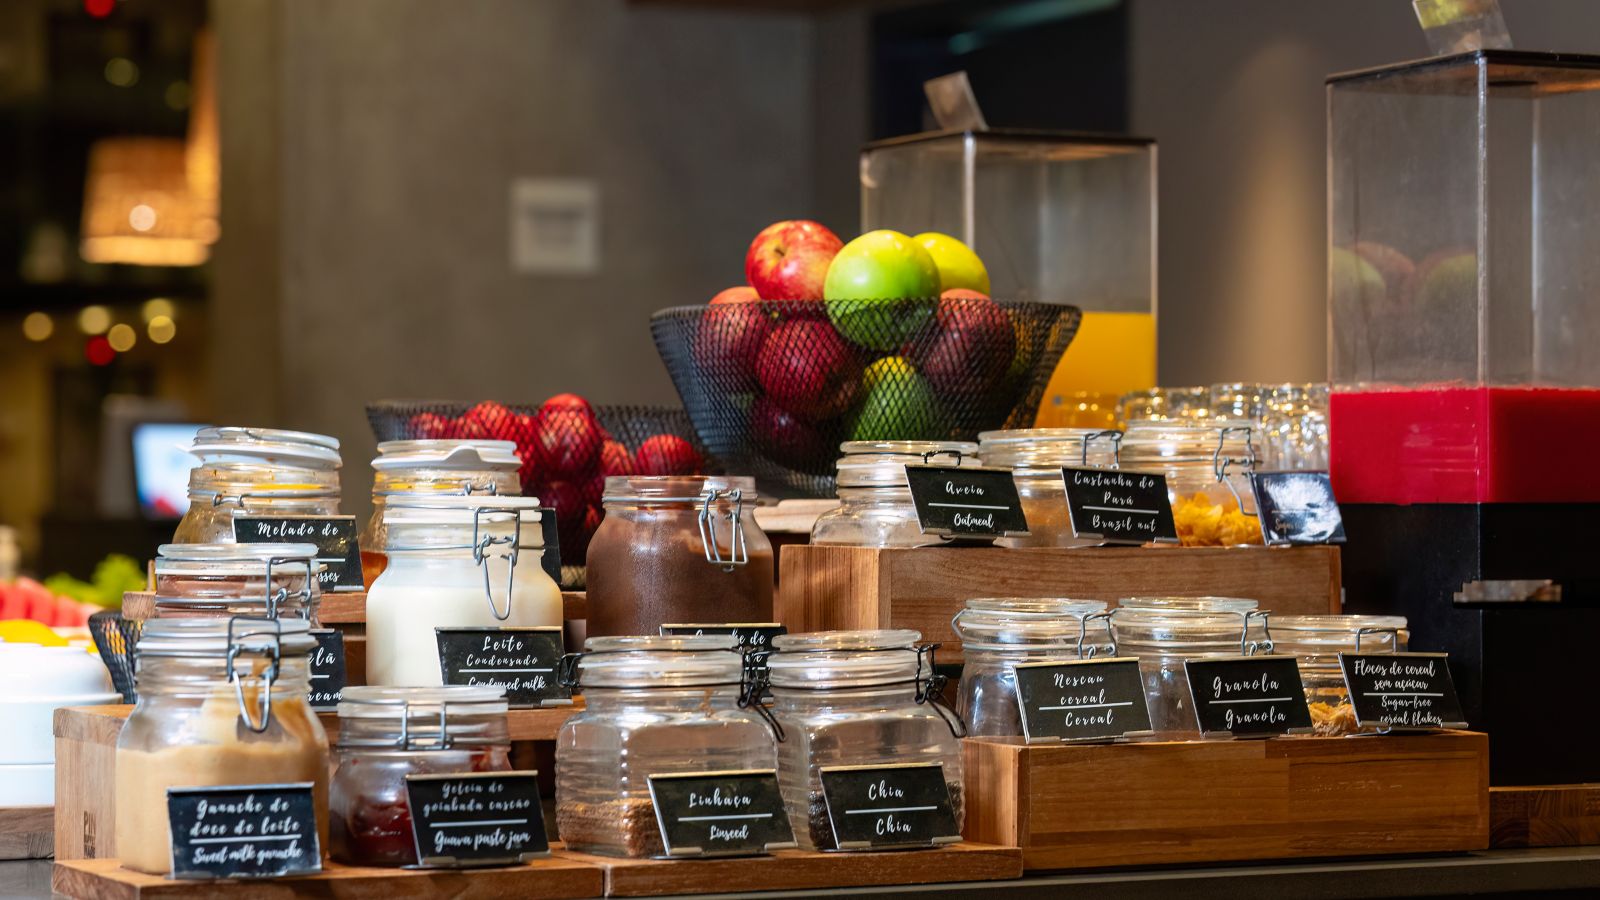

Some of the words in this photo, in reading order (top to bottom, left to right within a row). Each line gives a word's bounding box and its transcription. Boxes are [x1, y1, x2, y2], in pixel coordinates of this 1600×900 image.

[945, 480, 985, 496] Aveia
[1074, 471, 1133, 488] Castanha
[1139, 476, 1154, 489] do
[1103, 490, 1134, 505] Pará
[257, 520, 315, 538] Melado
[321, 522, 339, 536] de
[953, 512, 994, 528] Oatmeal
[1092, 514, 1132, 531] Brazil
[1137, 518, 1156, 532] nut
[482, 635, 523, 653] Leite
[466, 653, 538, 667] Condensado
[1354, 659, 1387, 676] Flocos
[1389, 661, 1403, 676] de
[1405, 660, 1436, 677] cereal
[523, 675, 546, 691] milk
[1053, 672, 1104, 688] Nescau
[1213, 673, 1279, 698] Granola
[1374, 680, 1392, 690] sem
[1060, 688, 1105, 705] cereal
[1065, 708, 1114, 727] Cereal
[1225, 706, 1286, 729] Granola
[1380, 712, 1409, 724] cereal
[1412, 711, 1442, 725] flakes
[488, 782, 504, 793] de
[868, 779, 904, 800] Chia
[689, 787, 752, 808] Linhaça
[197, 795, 262, 820] Ganache
[270, 797, 289, 812] de
[190, 820, 227, 836] doce
[233, 819, 255, 835] de
[260, 815, 300, 834] leite
[709, 824, 749, 841] Linseed
[876, 814, 911, 835] Chia
[434, 830, 473, 853] Guava
[474, 828, 507, 850] paste
[506, 831, 532, 850] jam
[192, 846, 228, 865] Sweet
[227, 844, 256, 863] milk
[256, 840, 303, 866] ganache
